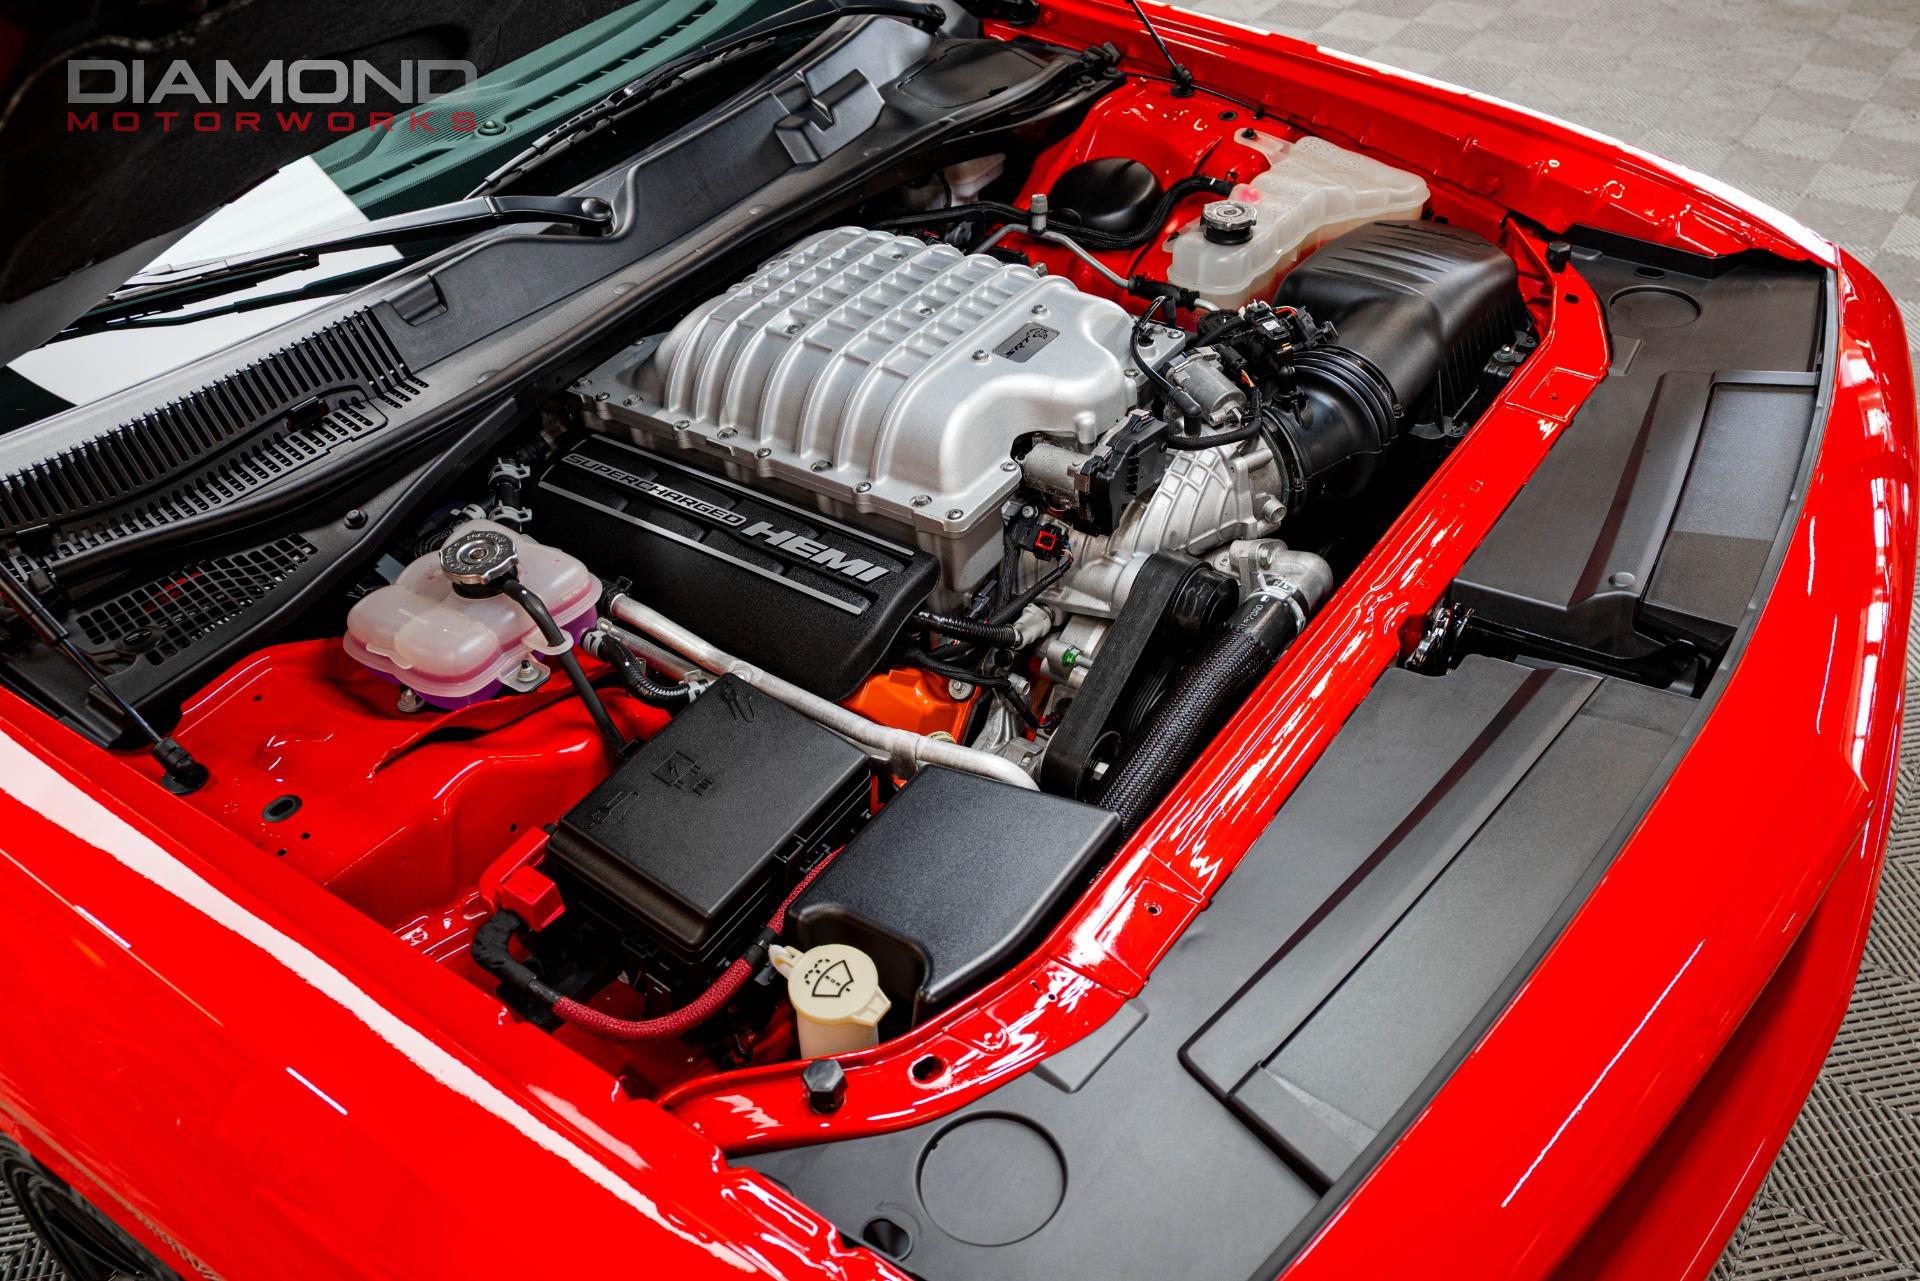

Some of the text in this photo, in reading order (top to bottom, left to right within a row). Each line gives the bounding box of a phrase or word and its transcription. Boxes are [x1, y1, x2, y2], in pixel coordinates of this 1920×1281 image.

[1006, 335, 1031, 359] SRT
[563, 454, 889, 582] SUPERCHARGED HEMI
